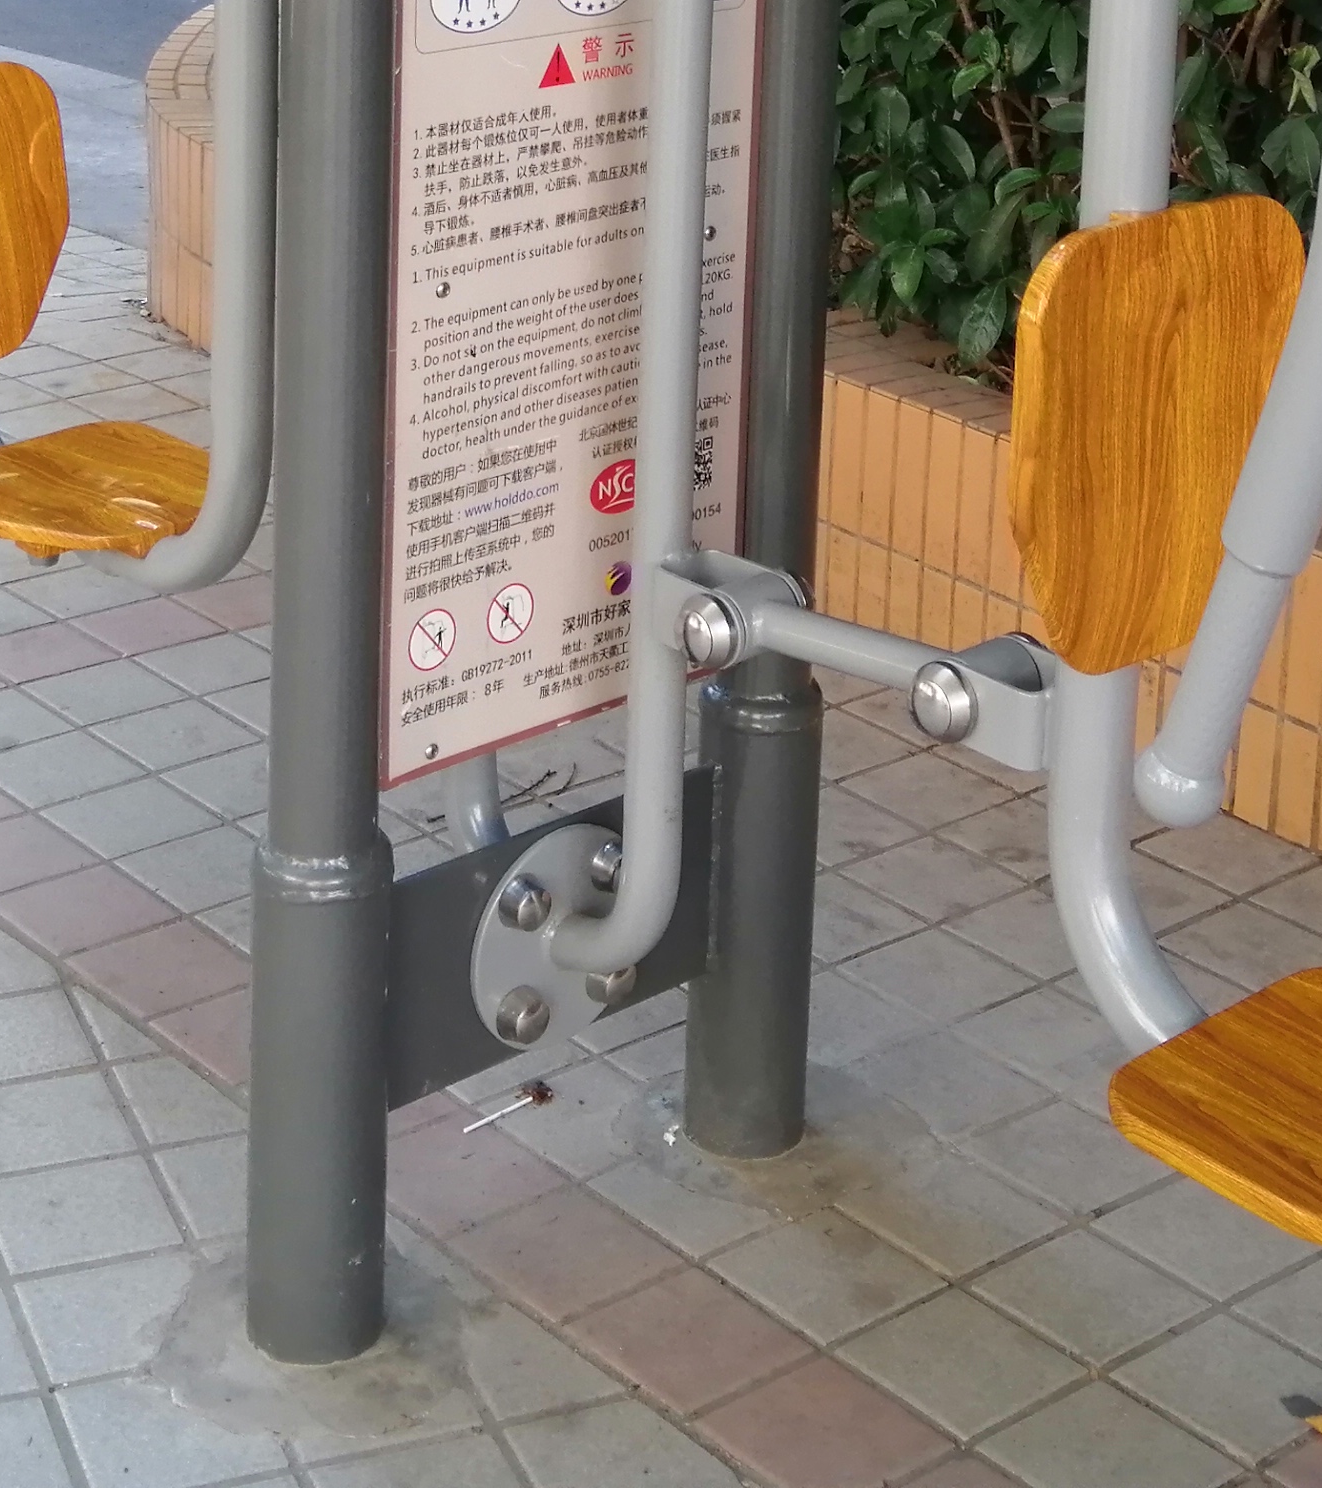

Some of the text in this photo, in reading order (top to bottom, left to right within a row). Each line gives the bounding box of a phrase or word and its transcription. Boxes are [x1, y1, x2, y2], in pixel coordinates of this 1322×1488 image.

[583, 63, 633, 81] WARNING
[413, 226, 644, 284] 1. This equipment is suitable for adults on
[411, 321, 420, 333] 2.
[424, 317, 444, 330] The
[448, 303, 507, 324] equipment
[510, 299, 529, 311] can
[532, 290, 554, 306] only
[557, 284, 571, 300] be
[574, 280, 598, 296] used
[601, 279, 614, 291] by
[617, 275, 636, 286] one
[702, 253, 735, 268] xercise
[424, 329, 469, 352] position
[473, 323, 493, 337] and
[496, 320, 514, 332] the
[516, 310, 553, 326] weight
[556, 305, 568, 318] of
[570, 303, 586, 314] the
[589, 298, 611, 311] user
[614, 291, 639, 305] does
[411, 359, 420, 371] 3.
[423, 356, 439, 368] Do
[443, 349, 461, 363] not
[464, 344, 477, 358] sit
[480, 342, 494, 354] on
[498, 337, 514, 348] the
[517, 322, 577, 344] equipment,
[581, 318, 595, 330] do
[598, 313, 615, 326] not
[701, 290, 714, 302] nd
[423, 370, 455, 386] other
[458, 354, 520, 378] dangerous
[523, 339, 592, 361] movements,
[595, 325, 640, 344] exercise
[710, 302, 733, 317] hold
[410, 339, 728, 426] 4. Alcohol, physical discomfort with cauti ease,
[423, 342, 641, 404] handrails to prevent falling, so as to avo
[423, 354, 732, 443] hypertension and other diseases patien in the
[422, 441, 462, 460] doctor,
[465, 428, 501, 448] health
[504, 419, 536, 437] under
[539, 413, 557, 427] the
[559, 400, 609, 425] guidance
[612, 395, 623, 408] of
[599, 464, 634, 504] NSC
[589, 528, 634, 552] 005201
